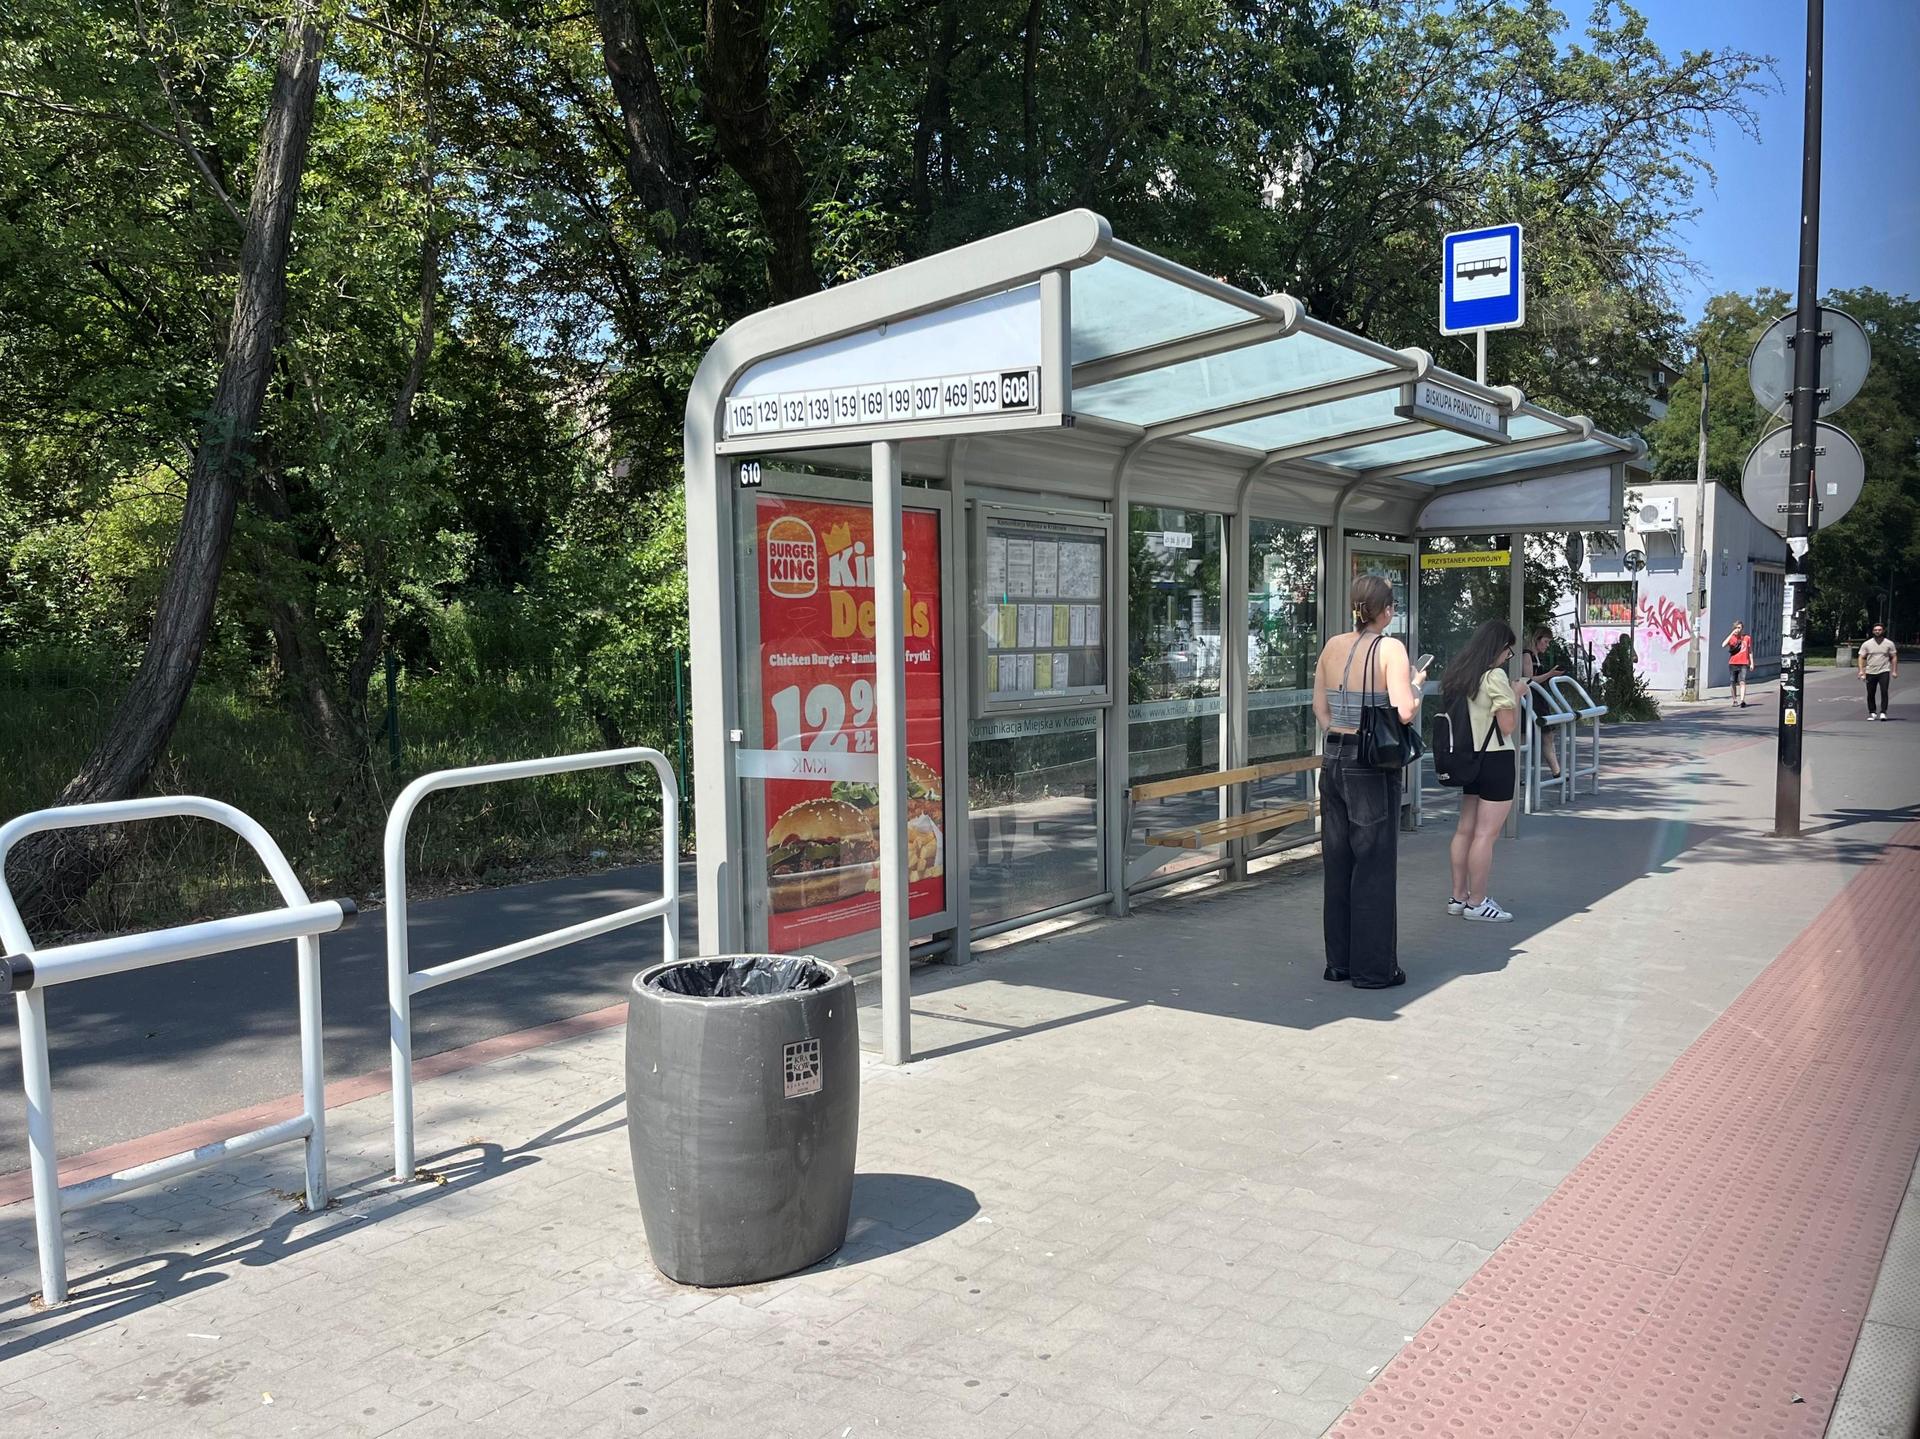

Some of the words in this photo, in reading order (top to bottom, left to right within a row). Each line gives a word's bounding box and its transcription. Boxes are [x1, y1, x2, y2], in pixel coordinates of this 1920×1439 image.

[733, 406, 753, 427] 105
[758, 401, 778, 423] 129
[783, 401, 804, 422] 132
[808, 398, 829, 420] 139
[834, 396, 856, 417] 159
[861, 392, 883, 414] 169
[888, 389, 910, 412] 199
[916, 387, 939, 410] 307
[945, 383, 967, 407] 469
[974, 380, 997, 404] 503
[1002, 376, 1029, 404] 608
[1425, 388, 1452, 410] BISKUPA
[1453, 398, 1485, 421] PRANDOTY
[740, 462, 761, 485] 610
[769, 542, 815, 559] BURGER
[1427, 557, 1467, 565] PRZYSTANEK
[770, 559, 815, 581] KING
[830, 589, 930, 638] Dels
[769, 653, 811, 667] Chicken
[812, 653, 844, 667] Burger
[905, 649, 931, 664] frytki
[851, 679, 877, 728] 9
[968, 721, 1022, 737] Komunikacja
[1024, 718, 1054, 733] Miejska
[1055, 719, 1062, 728] w
[1063, 714, 1097, 726] Krakowie
